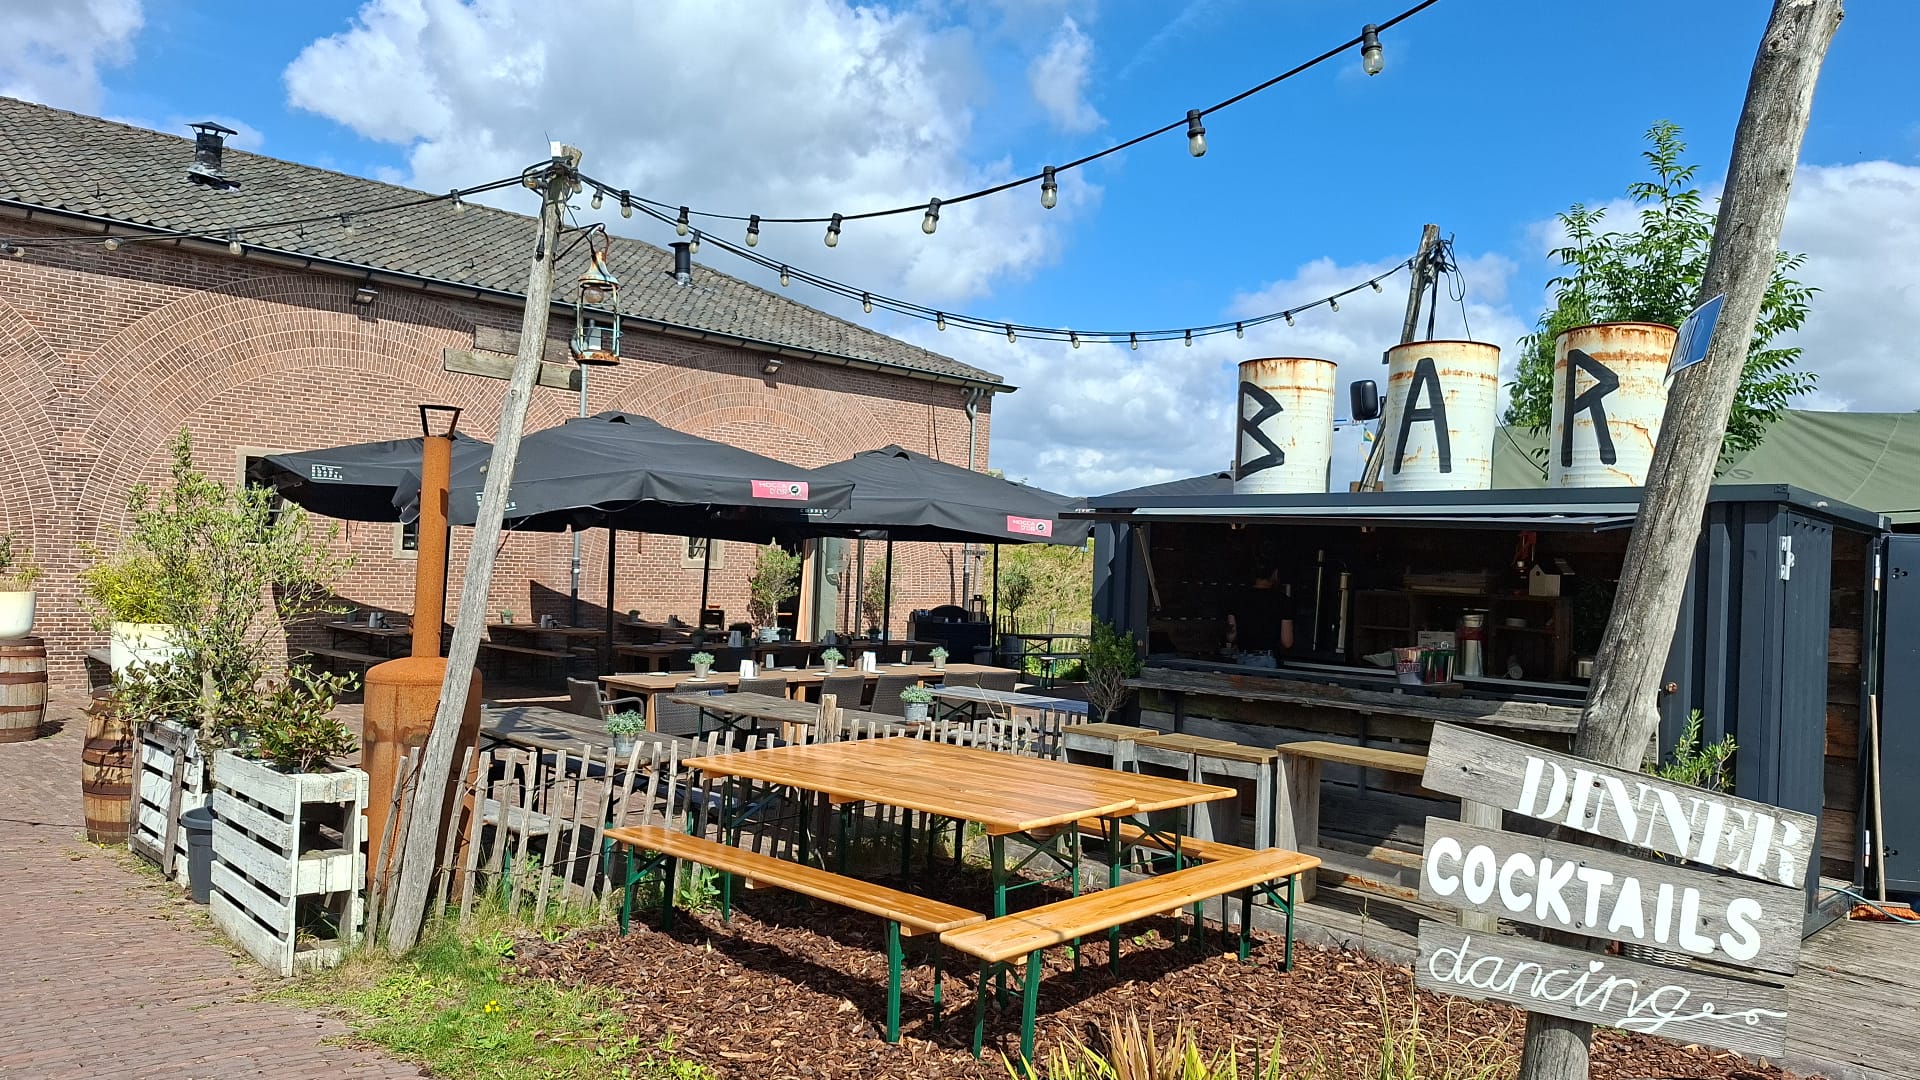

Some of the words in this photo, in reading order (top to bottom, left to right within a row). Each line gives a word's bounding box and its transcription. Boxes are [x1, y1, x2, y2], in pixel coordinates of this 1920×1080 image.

[1513, 755, 1804, 888] DINNER
[1426, 836, 1763, 961] COCKTAILS
[1428, 936, 1787, 1034] dancing
